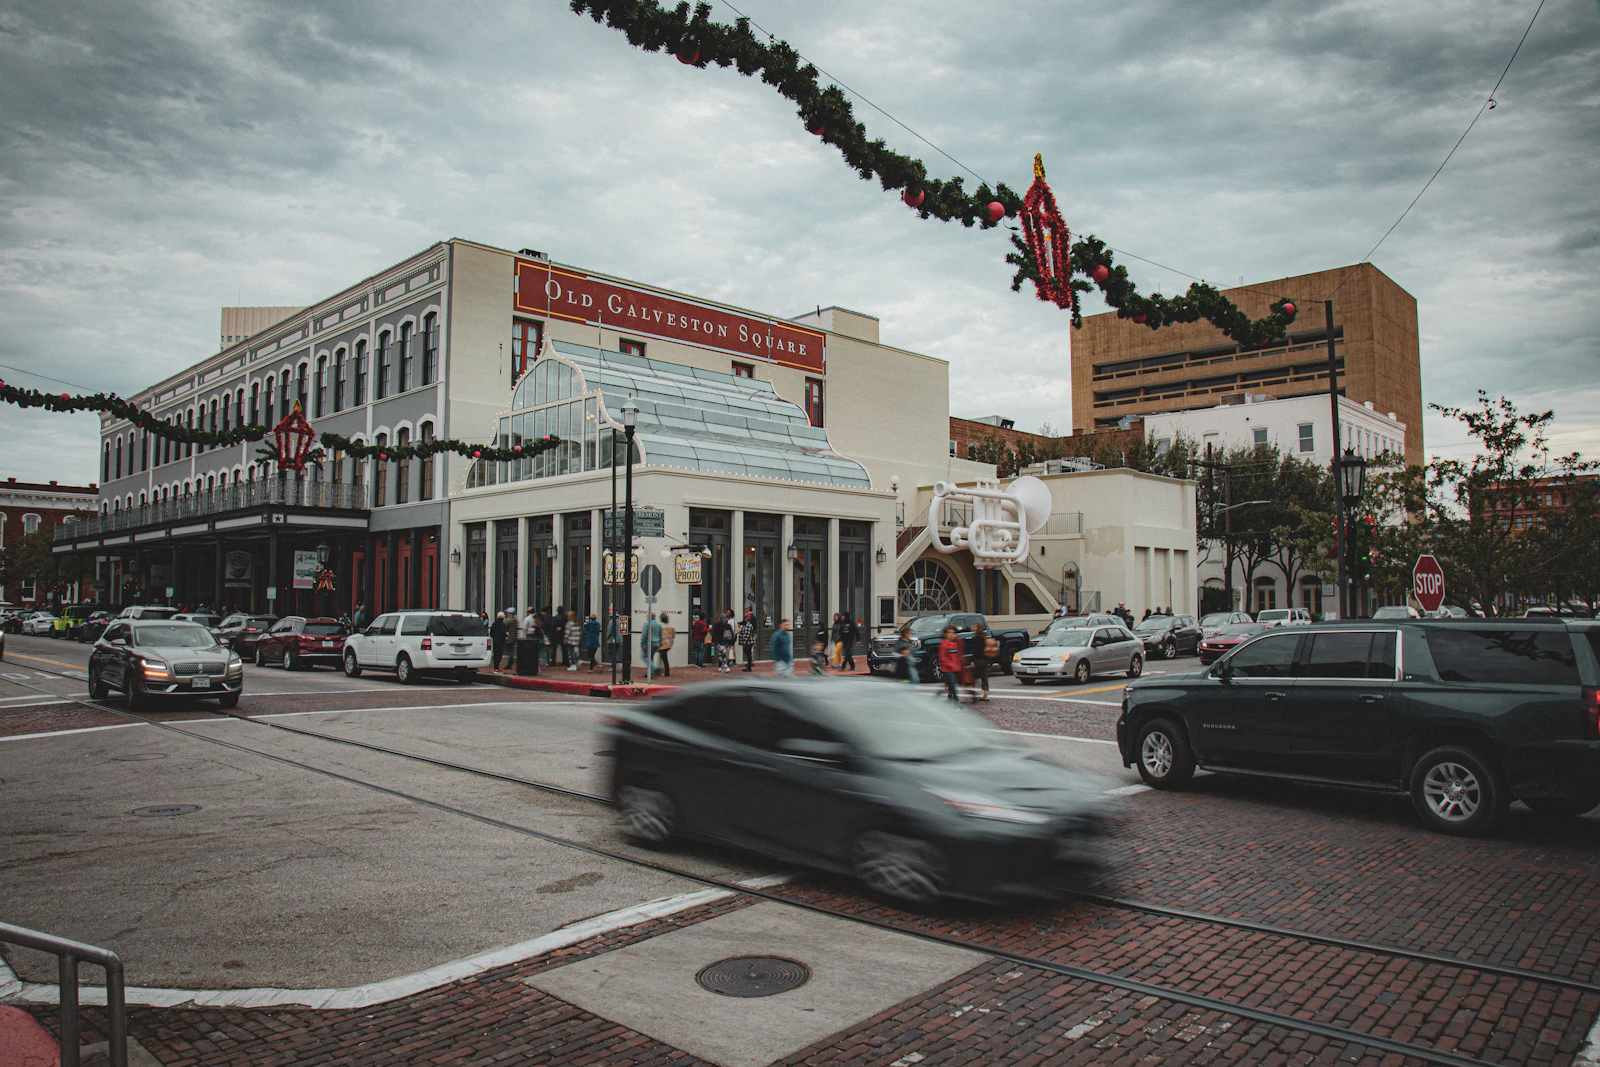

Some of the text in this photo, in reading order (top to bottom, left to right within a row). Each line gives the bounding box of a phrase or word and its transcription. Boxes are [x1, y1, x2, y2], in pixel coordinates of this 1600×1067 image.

[544, 279, 807, 356] OLD GALVESTON SQUARE
[676, 559, 688, 571] Old
[677, 571, 700, 580] PHOTO
[1416, 573, 1441, 594] STOP
